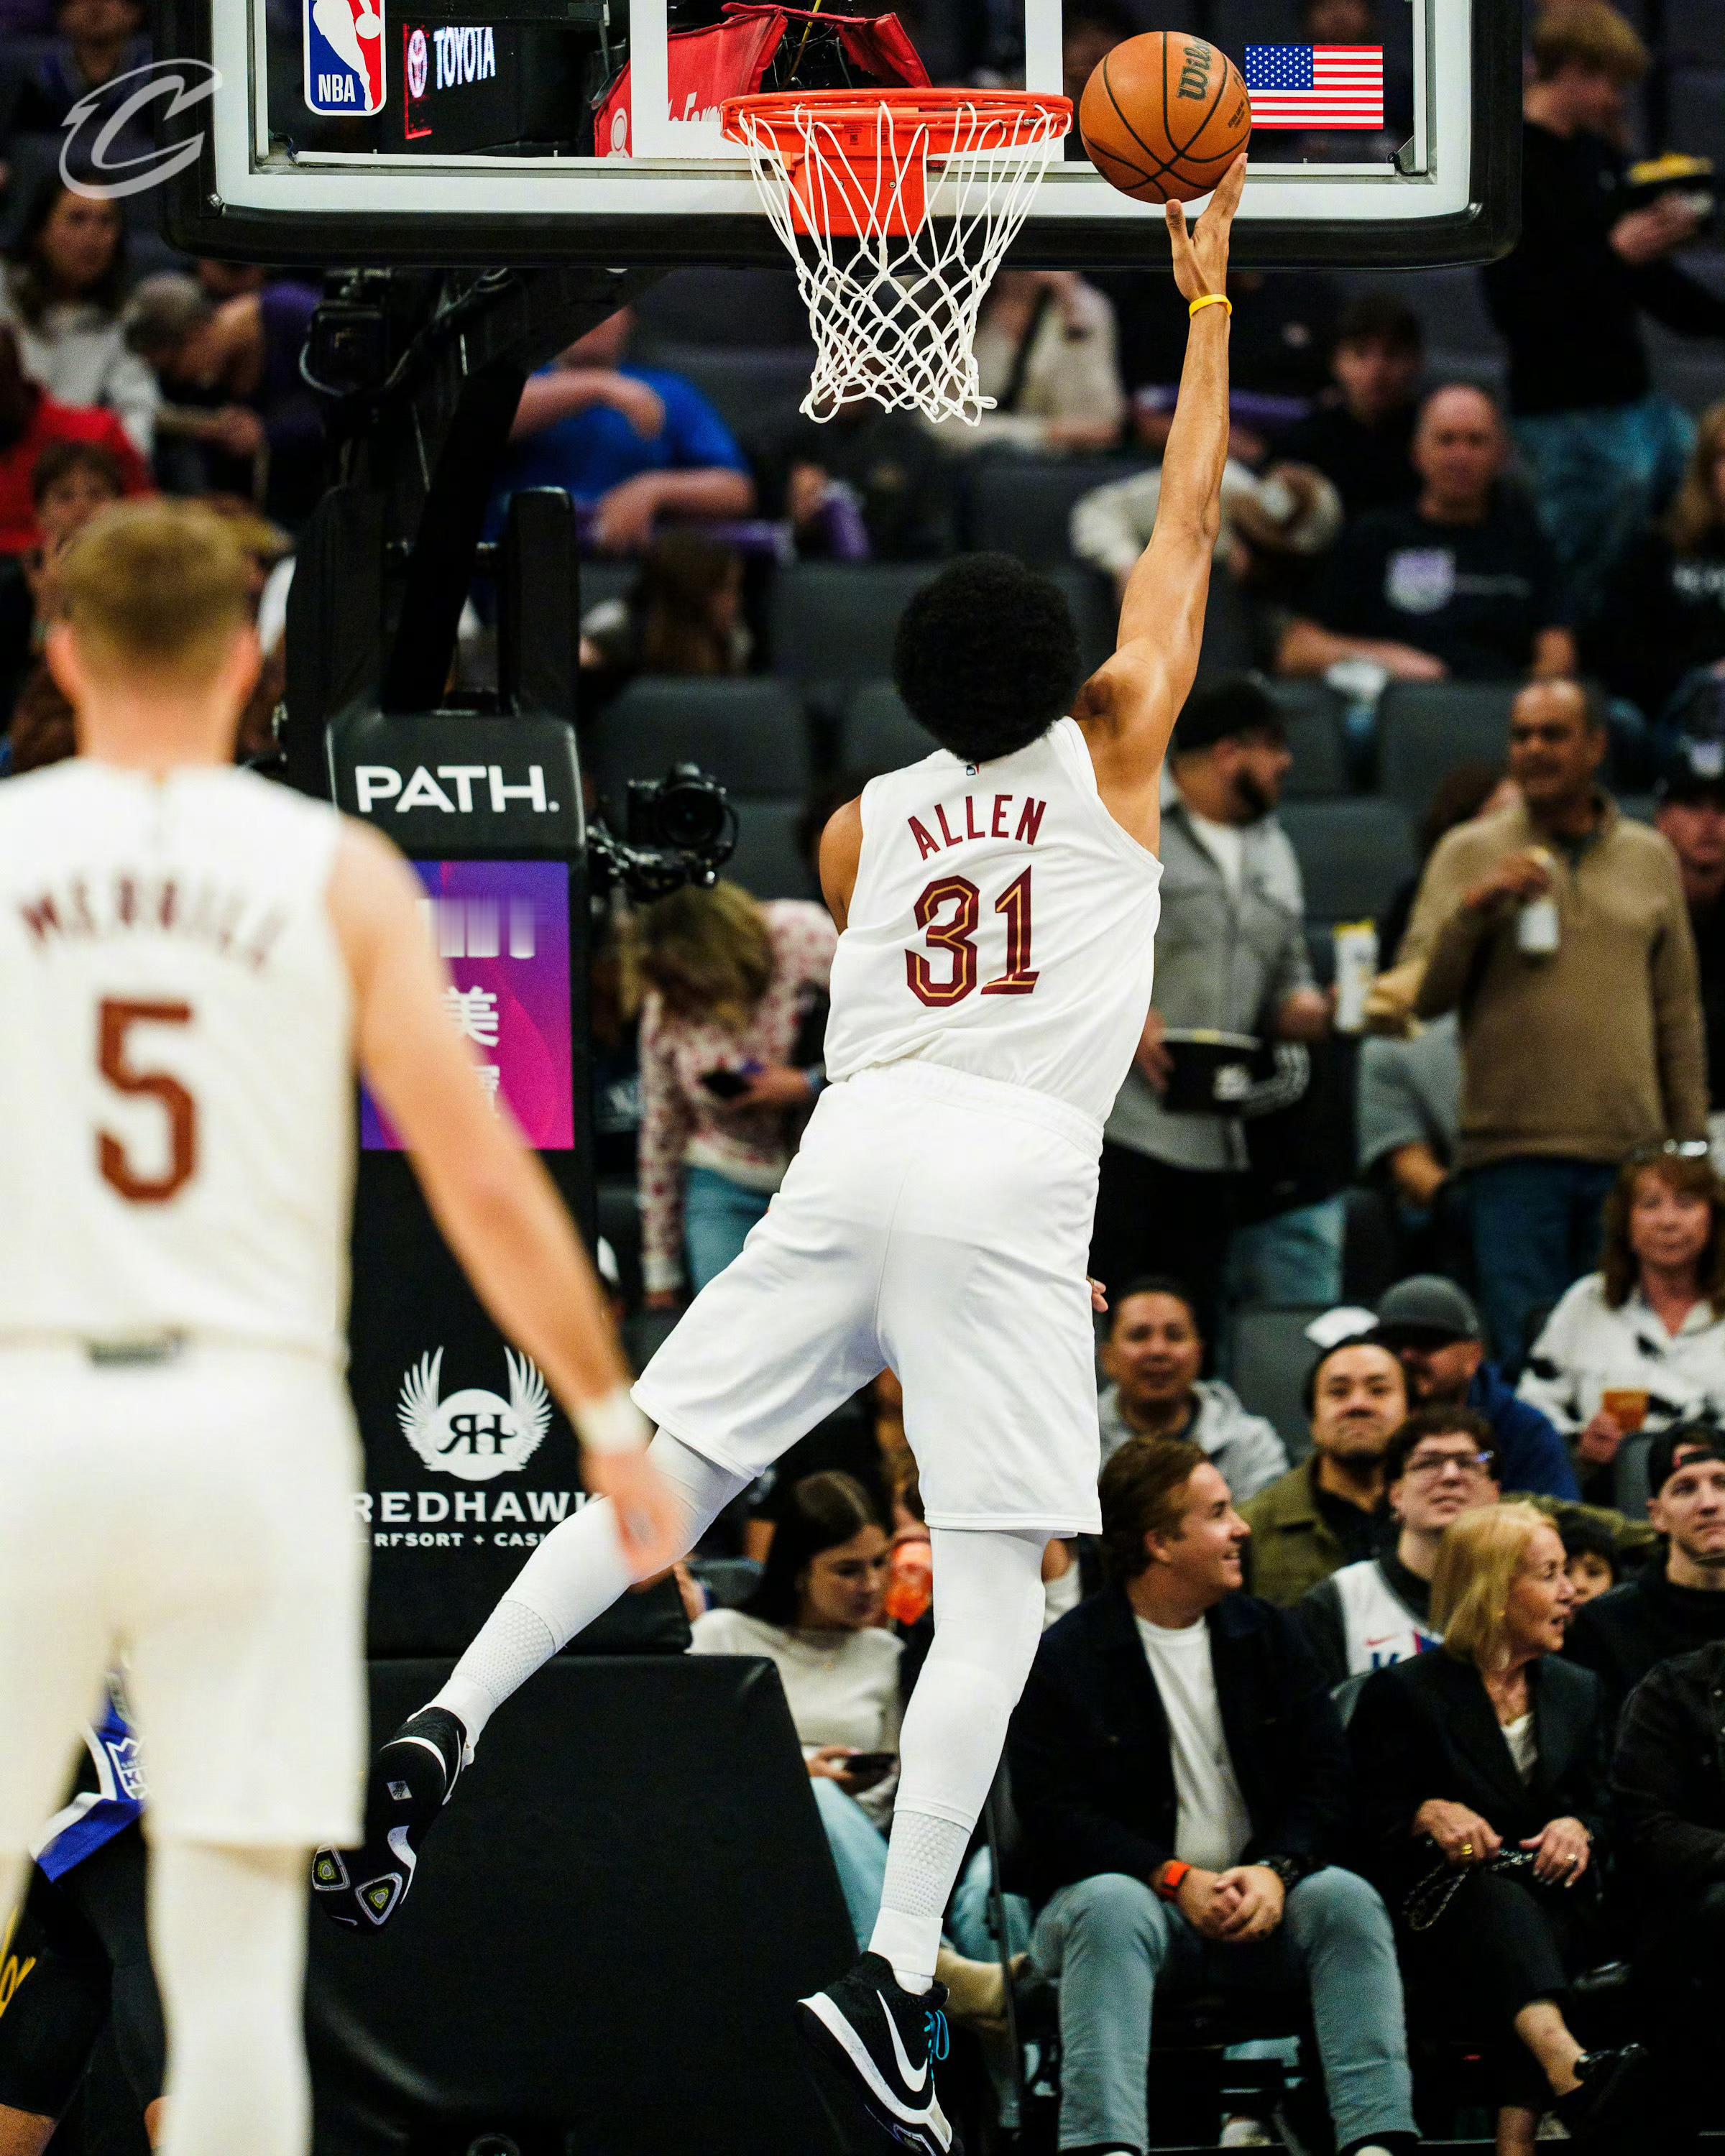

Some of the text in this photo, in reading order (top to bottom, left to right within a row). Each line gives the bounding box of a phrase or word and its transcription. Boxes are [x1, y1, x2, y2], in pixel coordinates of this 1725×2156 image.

[318, 74, 356, 103] NBA
[433, 26, 496, 90] TOYOTA
[908, 794, 1046, 861] ALLEN
[904, 865, 1040, 1007] 31
[97, 996, 197, 1204] 5
